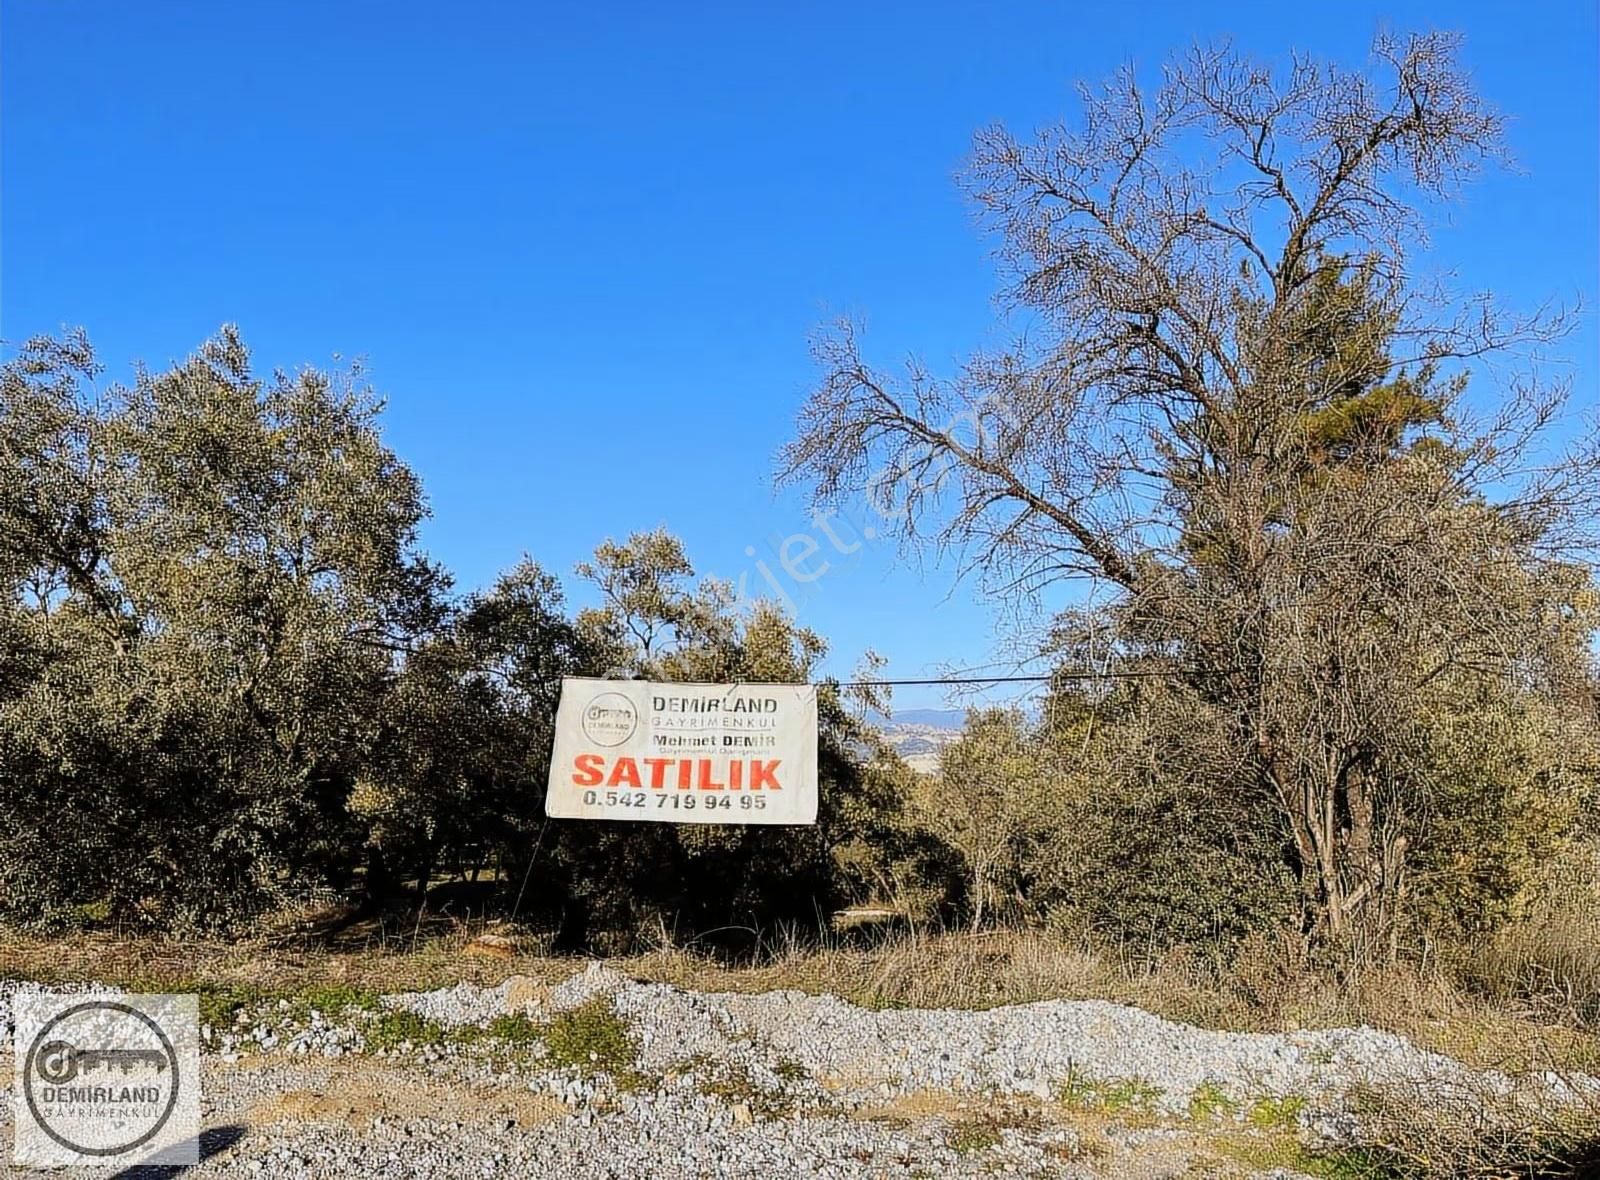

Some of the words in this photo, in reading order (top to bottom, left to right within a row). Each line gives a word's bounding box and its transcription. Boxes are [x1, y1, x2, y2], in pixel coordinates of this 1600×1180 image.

[653, 696, 777, 713] DEMİRLAND
[653, 735, 716, 746] Mehmet
[572, 754, 783, 790] SATILIK
[583, 790, 647, 808] 0.542
[655, 793, 697, 810] 719
[704, 795, 732, 810] 94
[740, 795, 767, 810] 95
